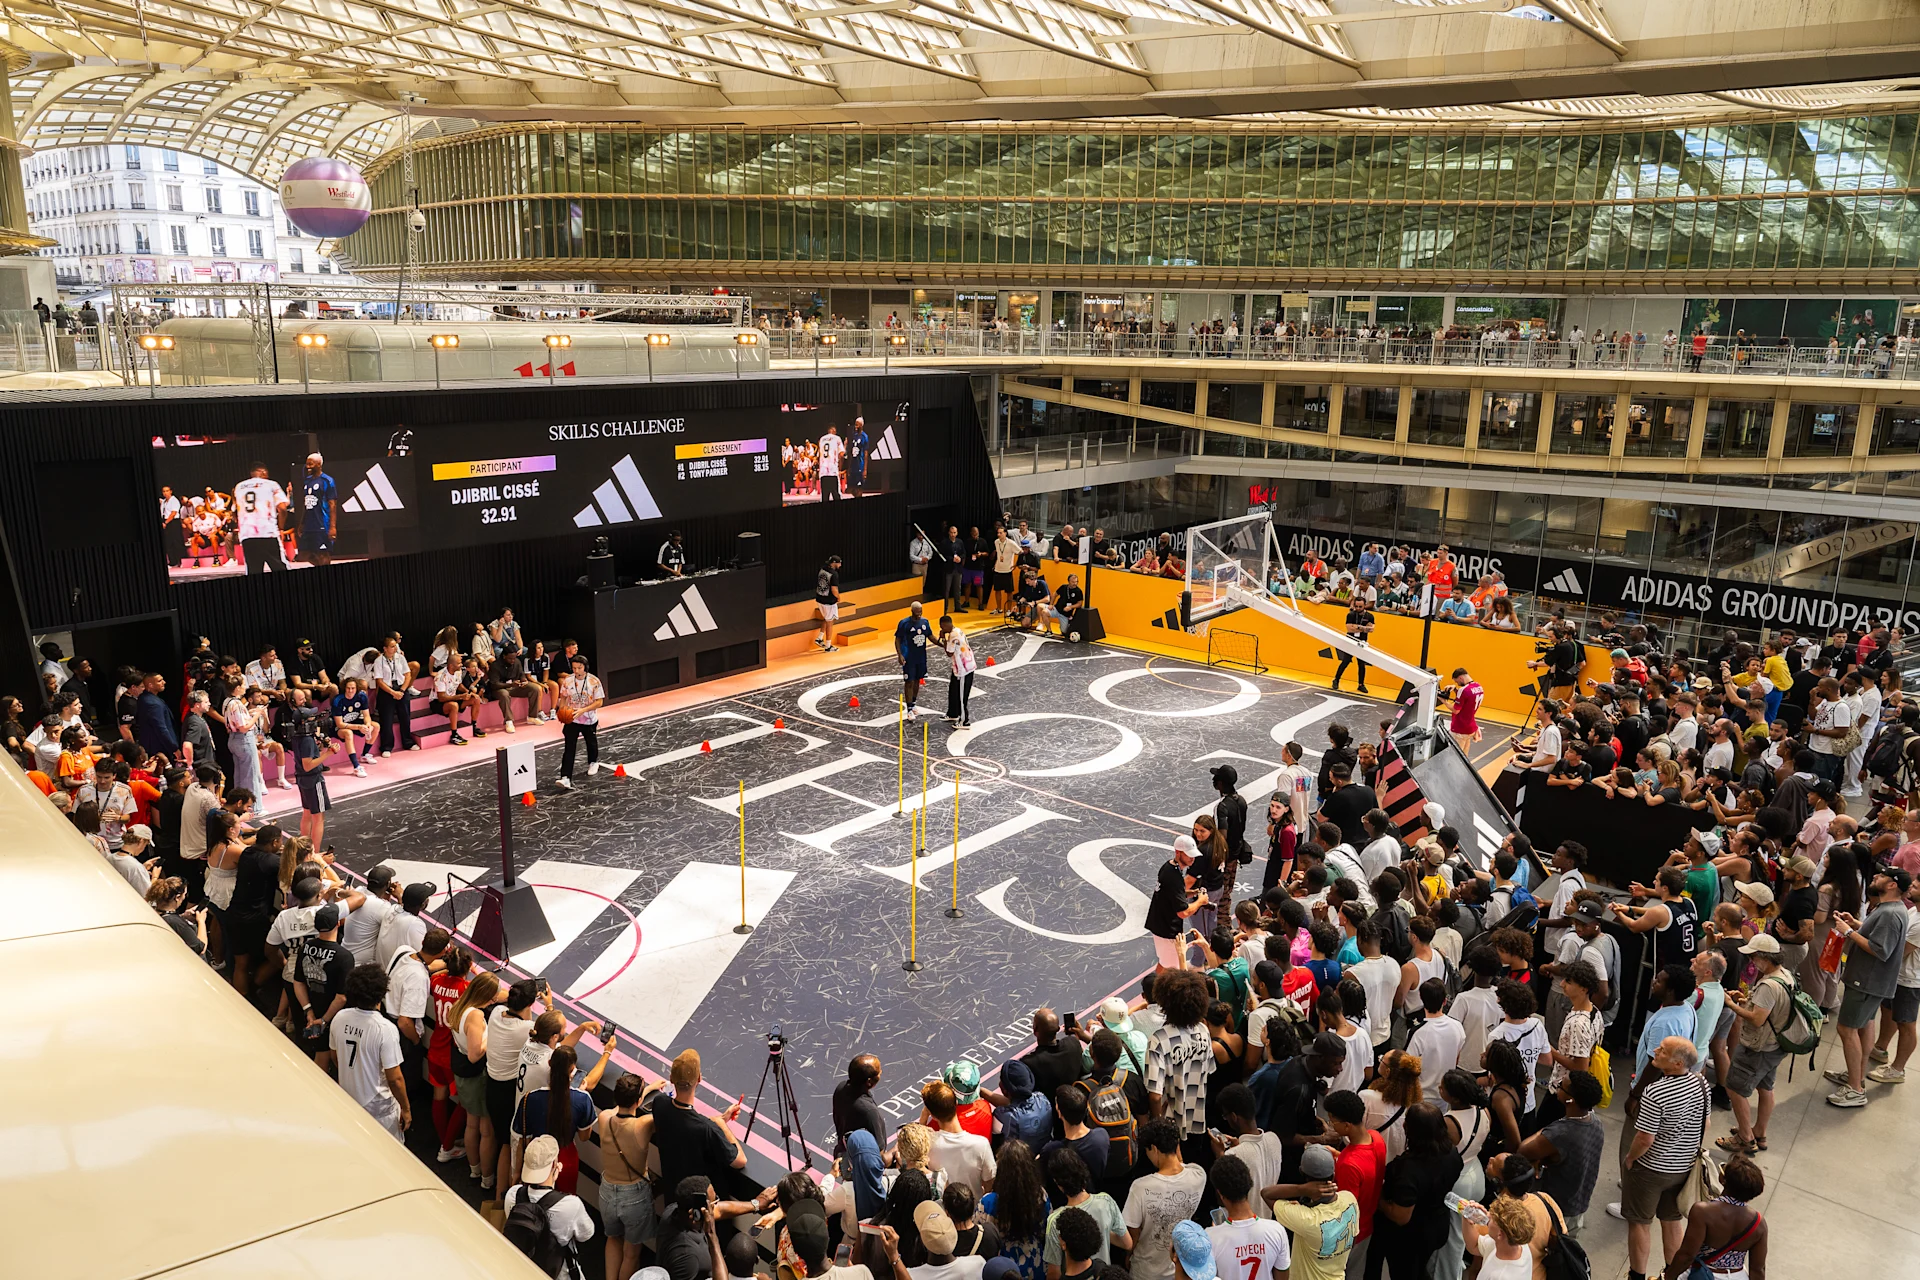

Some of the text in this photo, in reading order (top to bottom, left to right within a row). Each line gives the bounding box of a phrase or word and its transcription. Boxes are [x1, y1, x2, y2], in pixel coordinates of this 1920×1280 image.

[327, 187, 355, 199] Westfield
[549, 417, 685, 441] SKILLS CHALLENGE
[703, 443, 742, 454] CLASSEMENT
[470, 460, 523, 475] PARTICIPANT
[677, 455, 769, 472] #1 DJIBRIL CISSÉ 32.91
[677, 463, 769, 480] #2 TONY PARKER 38.15
[451, 478, 540, 505] DJIBRIL CISSÉ
[481, 505, 517, 524] 32.91
[1288, 533, 1355, 563] ADIDAS
[1621, 575, 1920, 635] ADIDAS GROUNDPARIS
[1682, 923, 1695, 952] 5
[303, 943, 336, 961] ROME
[344, 1024, 364, 1039] EVAN
[345, 1039, 358, 1068] 7
[517, 1063, 527, 1093] 8
[1235, 1243, 1266, 1258] ZIYECH
[1240, 1256, 1262, 1280] 7
